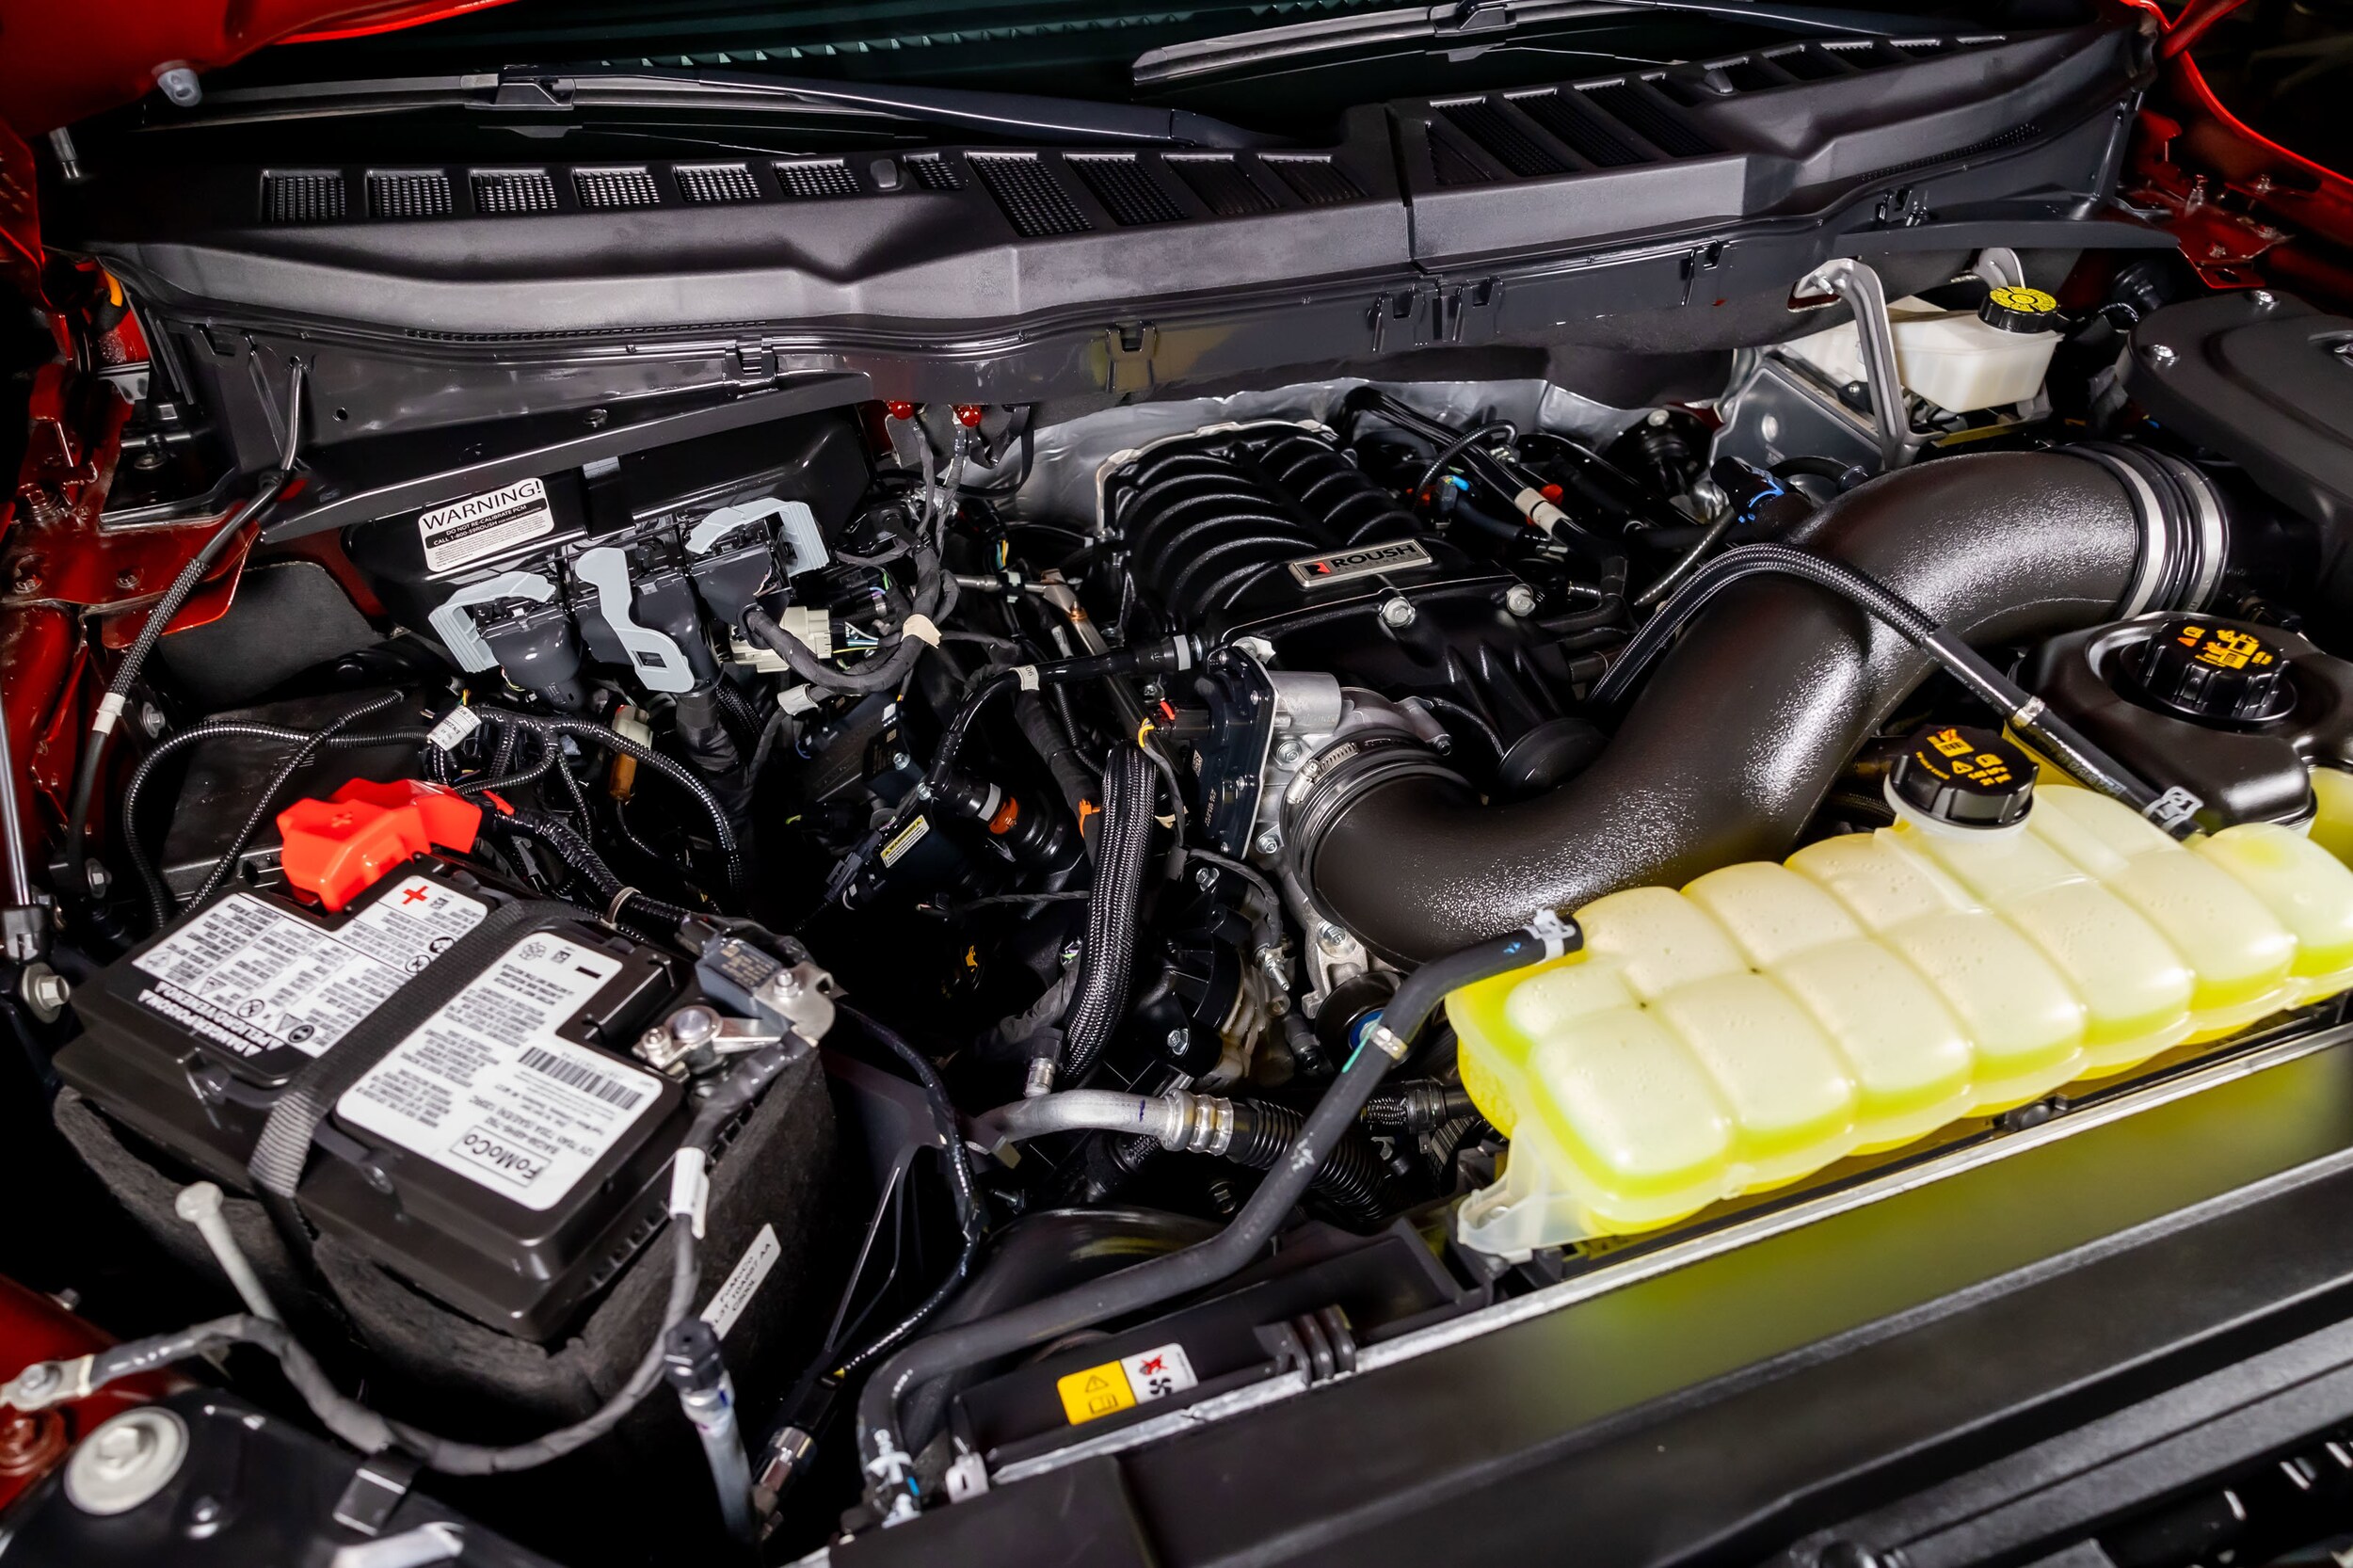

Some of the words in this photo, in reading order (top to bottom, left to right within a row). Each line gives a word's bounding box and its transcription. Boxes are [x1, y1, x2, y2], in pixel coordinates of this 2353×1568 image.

[423, 481, 542, 530] WARNING!
[457, 524, 471, 534] NOT
[471, 509, 513, 528] RE-CALIBRATE
[512, 504, 527, 514] PCM
[433, 537, 450, 546] CALL
[450, 520, 498, 540] 1-800-59ROUSH
[1330, 545, 1417, 568] ROUSH
[464, 1134, 543, 1179] FoMoCo
